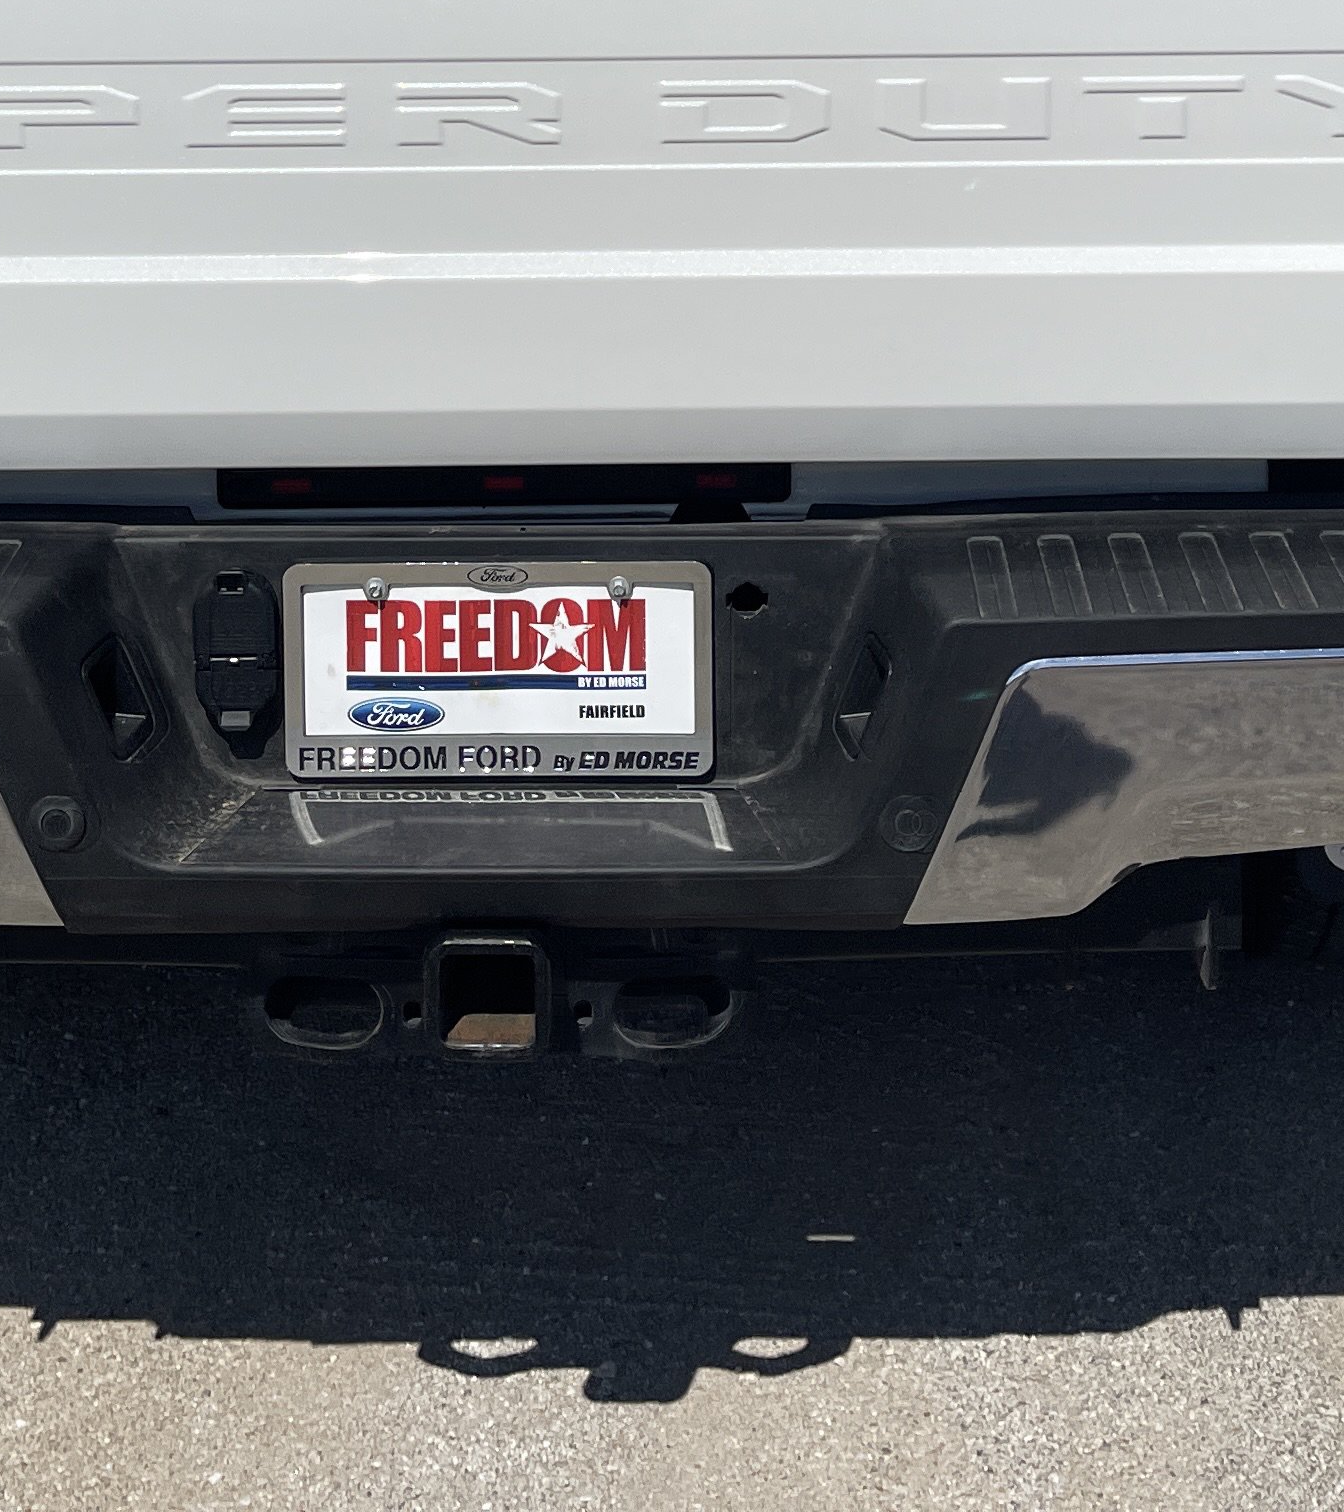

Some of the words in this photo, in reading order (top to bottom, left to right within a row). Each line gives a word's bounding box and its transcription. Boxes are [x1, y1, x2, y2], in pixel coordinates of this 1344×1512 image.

[480, 568, 517, 583] Ford
[346, 598, 646, 673] FREEDOM
[577, 676, 592, 688] BY
[593, 676, 607, 688] ED
[608, 676, 645, 688] MORSE
[367, 702, 425, 727] Ford
[578, 704, 646, 719] FAIRFIELD
[299, 745, 447, 772] FREEDOM
[458, 745, 542, 772] FORD
[578, 751, 611, 770] ED
[614, 751, 700, 770] MORSE
